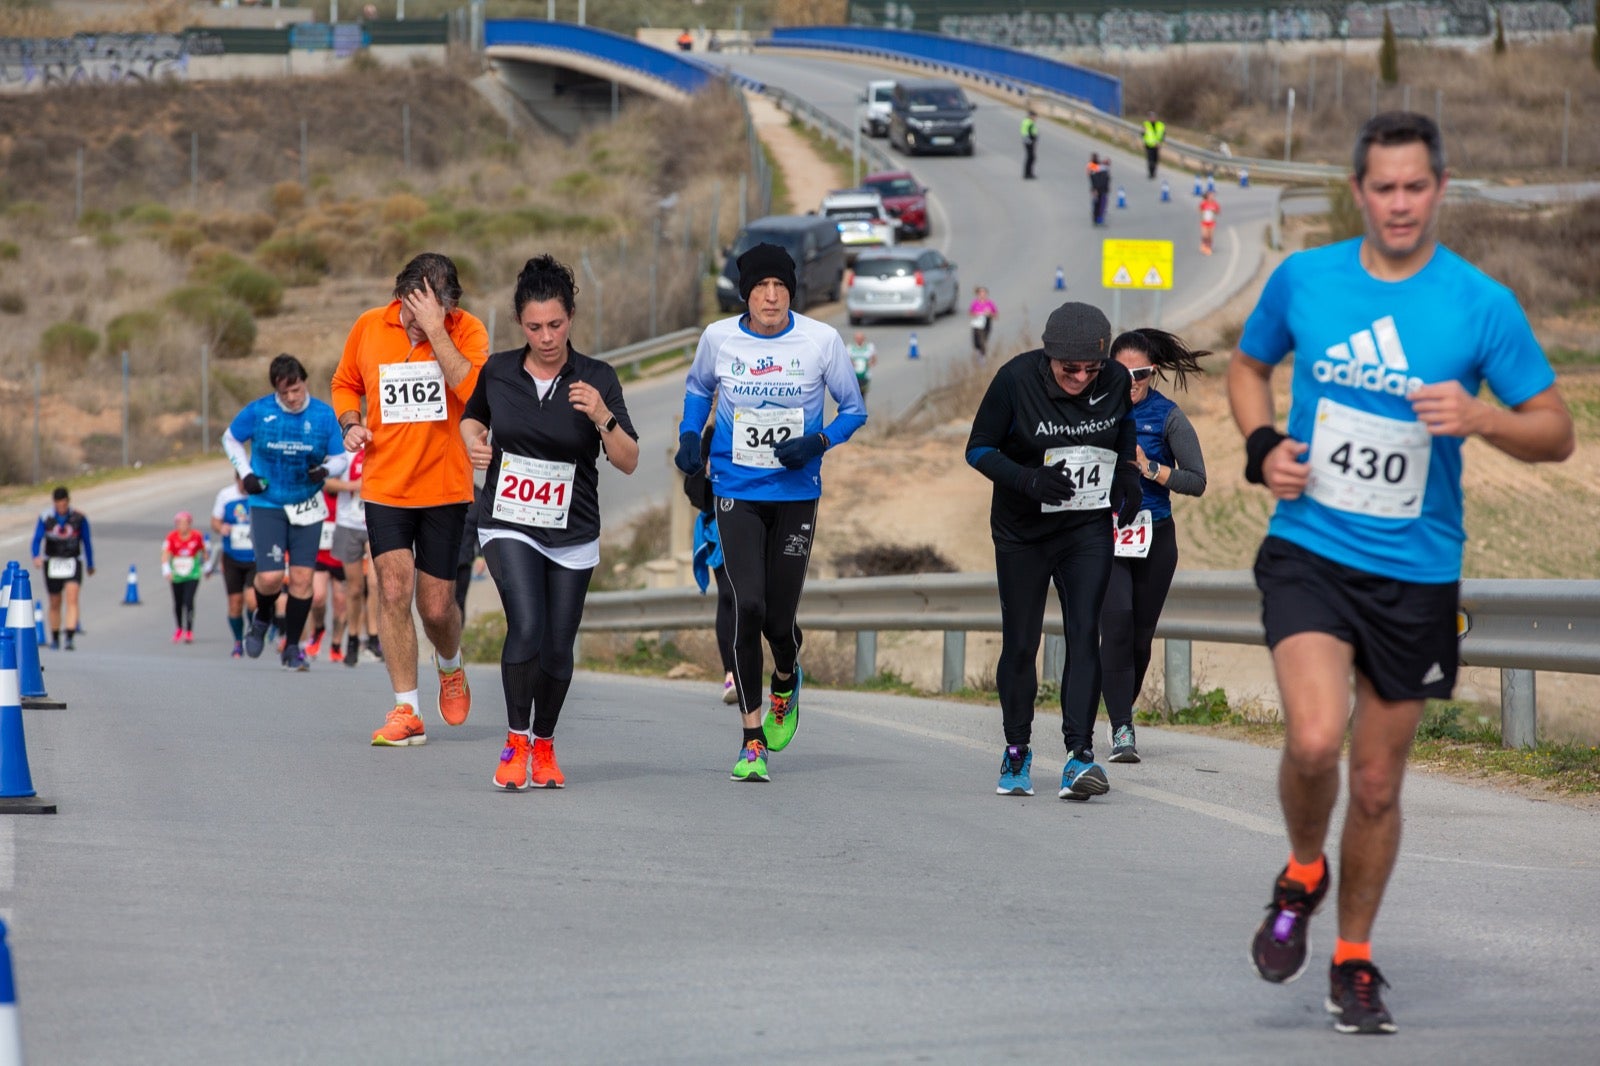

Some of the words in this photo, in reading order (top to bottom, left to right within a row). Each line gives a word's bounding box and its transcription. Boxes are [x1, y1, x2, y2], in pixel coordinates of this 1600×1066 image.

[756, 356, 774, 370] 35
[384, 381, 442, 405] 3162
[732, 384, 802, 397] MARACENA
[1035, 417, 1116, 436] Almuñécar
[746, 426, 791, 449] 342
[1330, 442, 1407, 484] 430
[501, 475, 565, 506] 2041
[1114, 525, 1146, 545] 21
